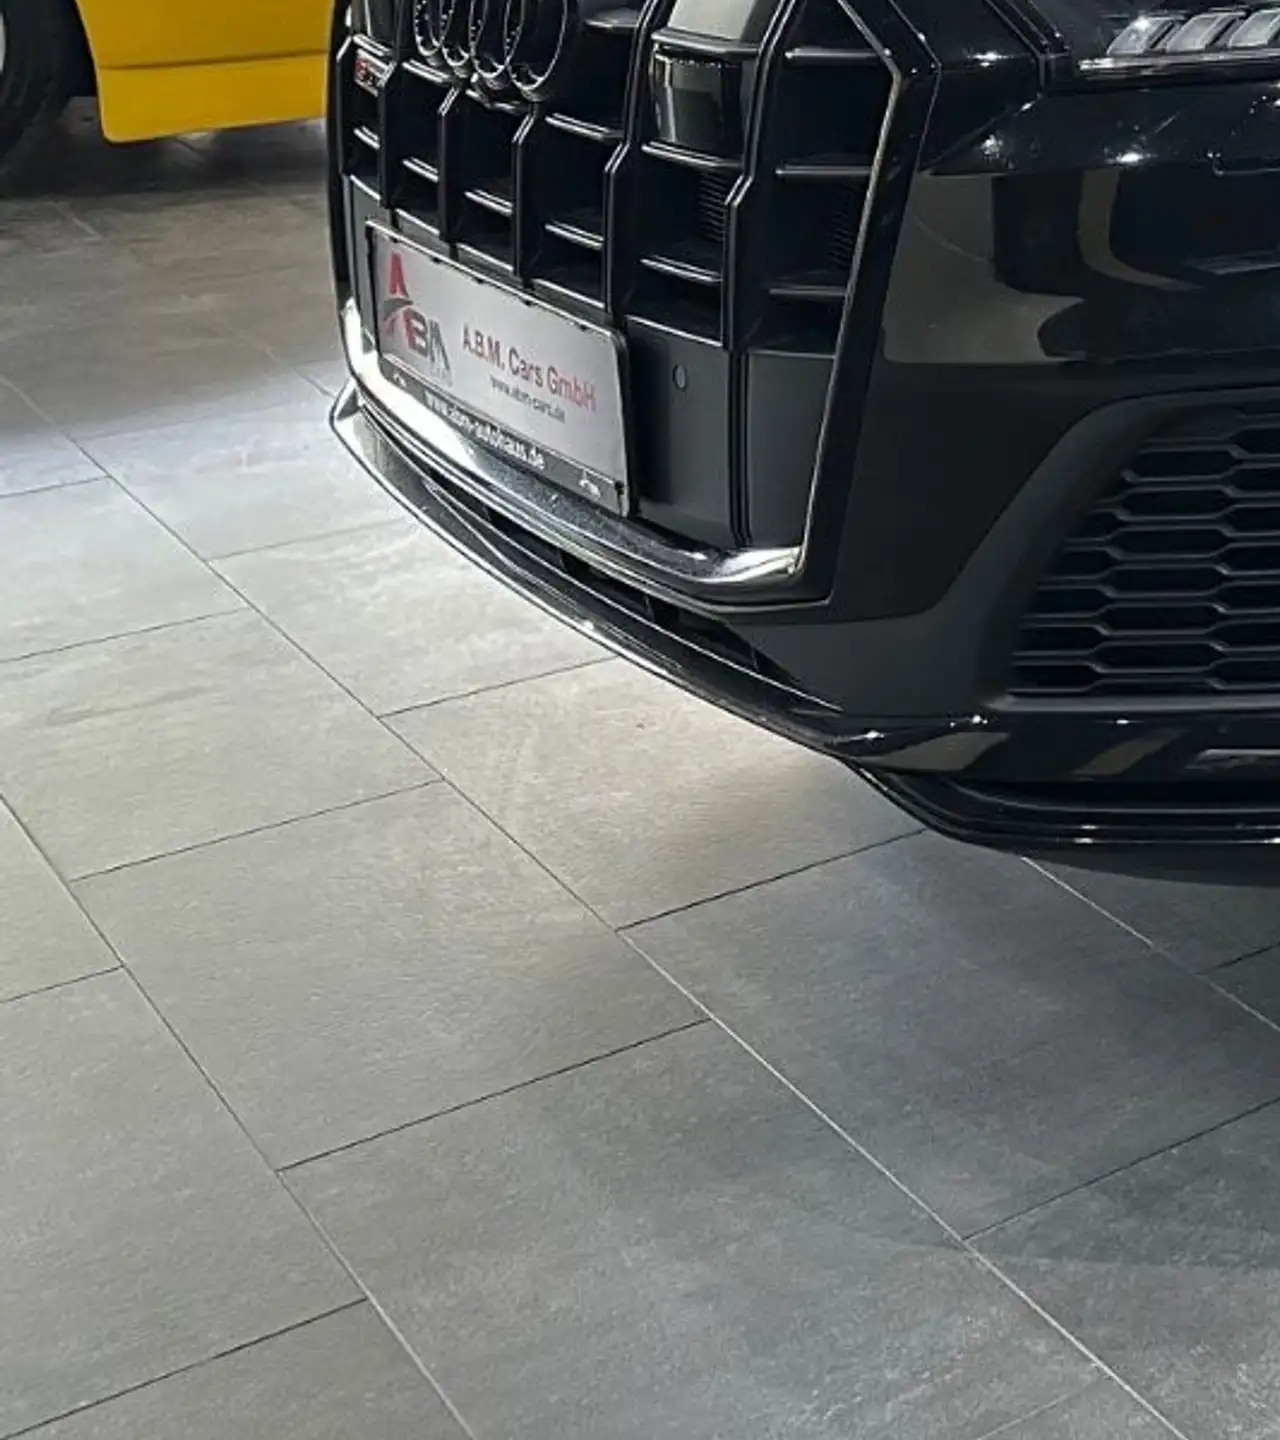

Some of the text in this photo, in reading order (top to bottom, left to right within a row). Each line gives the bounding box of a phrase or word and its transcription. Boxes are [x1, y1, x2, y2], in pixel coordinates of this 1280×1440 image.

[462, 323, 597, 412] A.B.M. Cars GmbH
